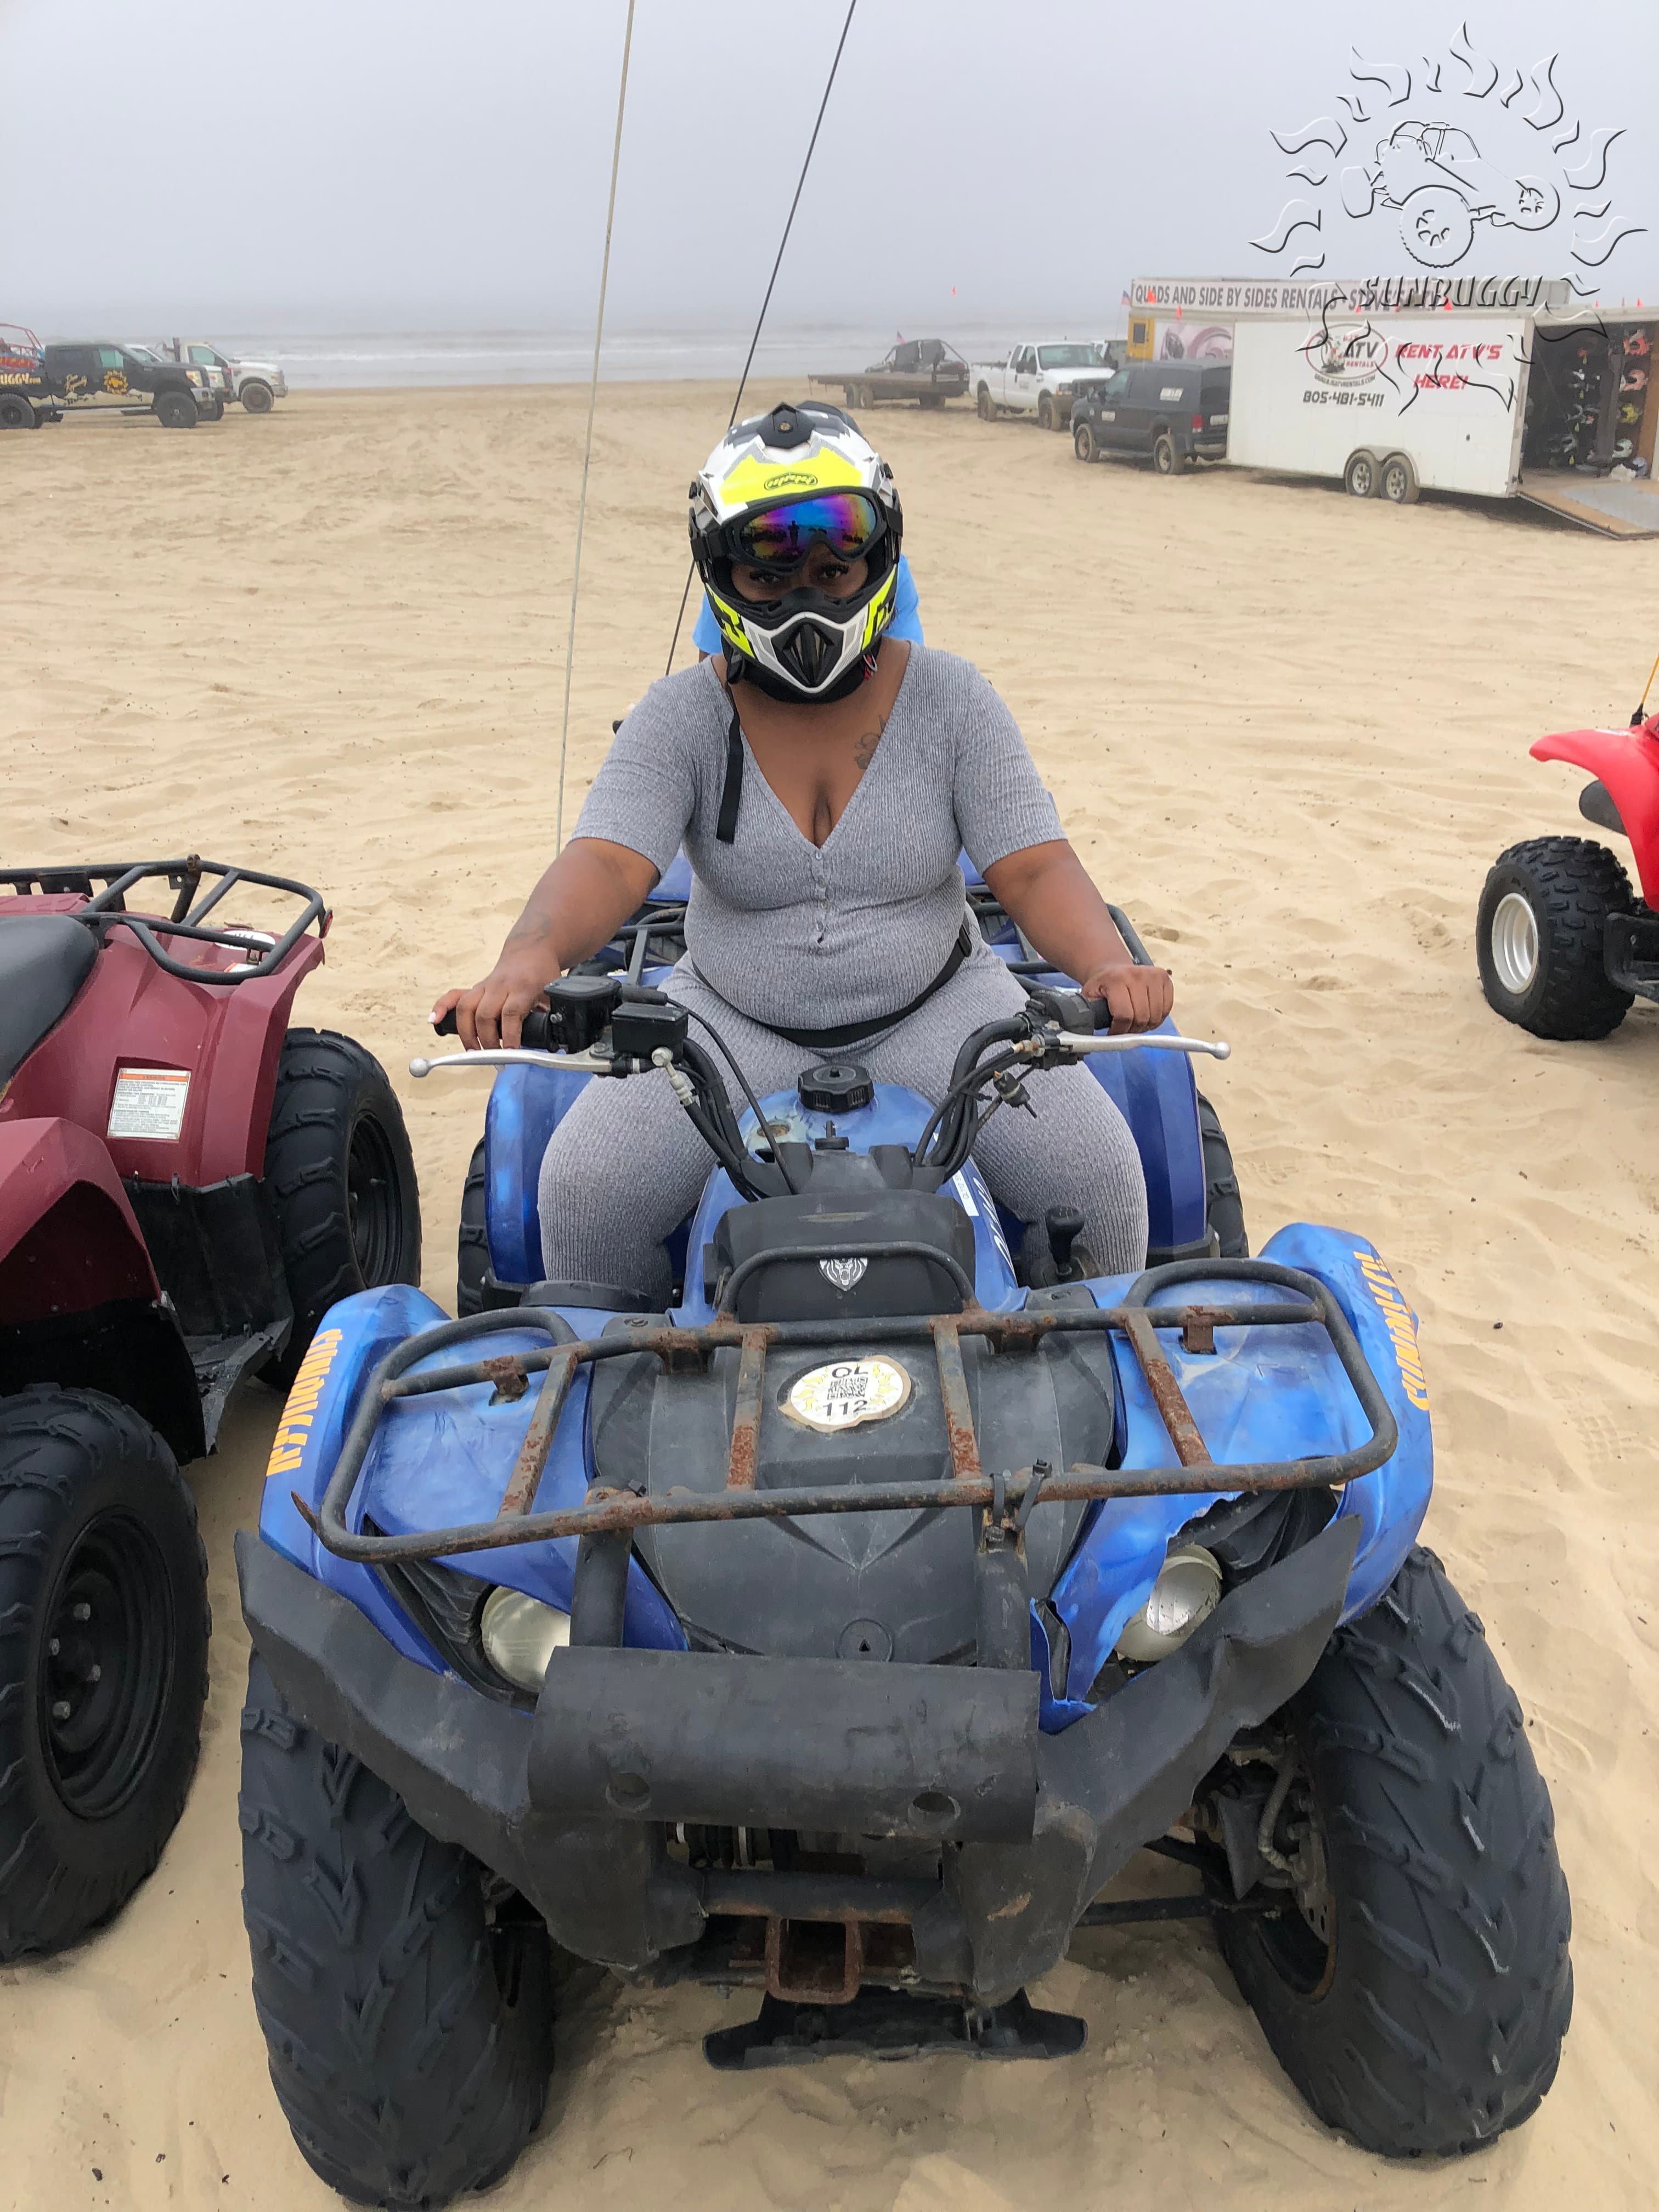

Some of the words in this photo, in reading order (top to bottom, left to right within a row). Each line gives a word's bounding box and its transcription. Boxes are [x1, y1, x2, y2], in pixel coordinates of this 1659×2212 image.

[1172, 286, 1197, 305] AND
[1199, 287, 1225, 306] SIDE
[1226, 287, 1242, 307] BY
[1244, 287, 1278, 308] SIDES
[1280, 288, 1338, 310] RENTALS
[1343, 342, 1379, 358] ATV
[1395, 344, 1443, 359] RENT
[1445, 344, 1503, 360] ATV'S
[1413, 373, 1469, 390] HERE!
[1303, 390, 1385, 407] 805-481-5411
[832, 1365, 868, 1379] OL
[823, 1400, 868, 1417] 112
